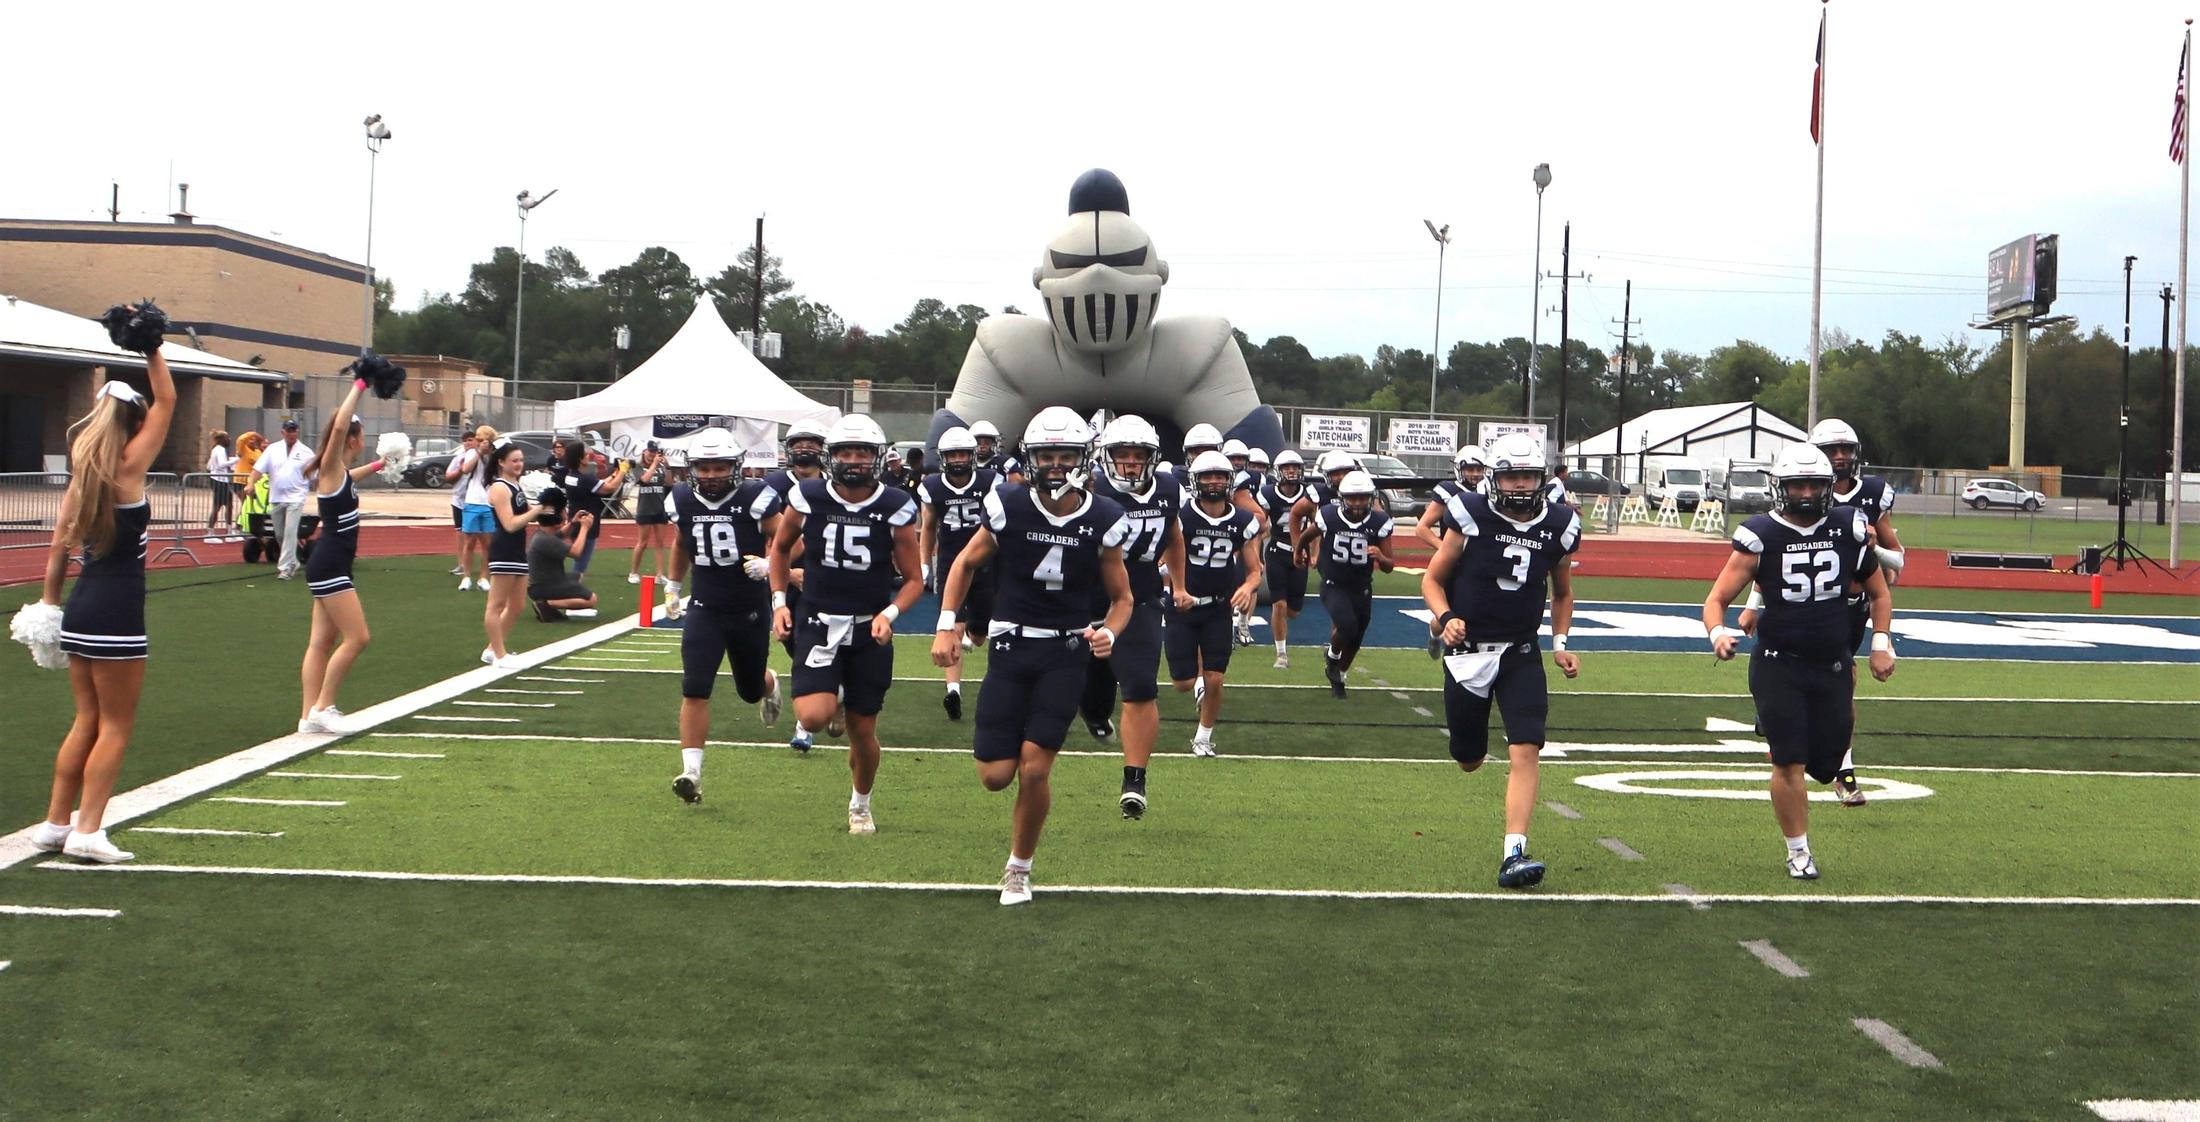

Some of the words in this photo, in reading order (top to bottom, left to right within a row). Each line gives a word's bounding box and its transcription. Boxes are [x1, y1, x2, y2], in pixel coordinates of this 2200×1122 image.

[1307, 431, 1330, 440] STATE
[1331, 432, 1363, 442] CHAMPS
[1396, 435, 1419, 444] STATE
[1420, 436, 1451, 446] CHAMPS
[692, 515, 733, 523] CRUSADERS
[826, 514, 872, 525] CRUSADERS
[943, 502, 982, 532] 45
[691, 522, 739, 567] 18
[821, 522, 871, 571] 15
[1026, 531, 1080, 546] CRUSADERS
[1122, 517, 1166, 562] 77
[1195, 529, 1230, 538] CRUSADERS
[1495, 534, 1543, 550] CRUSADERS
[1786, 541, 1834, 552] CRUSADERS
[1188, 536, 1233, 568] 32
[1332, 533, 1368, 566] 59
[1033, 544, 1064, 590] 4
[1496, 545, 1531, 591] 3
[1781, 550, 1842, 603] 52
